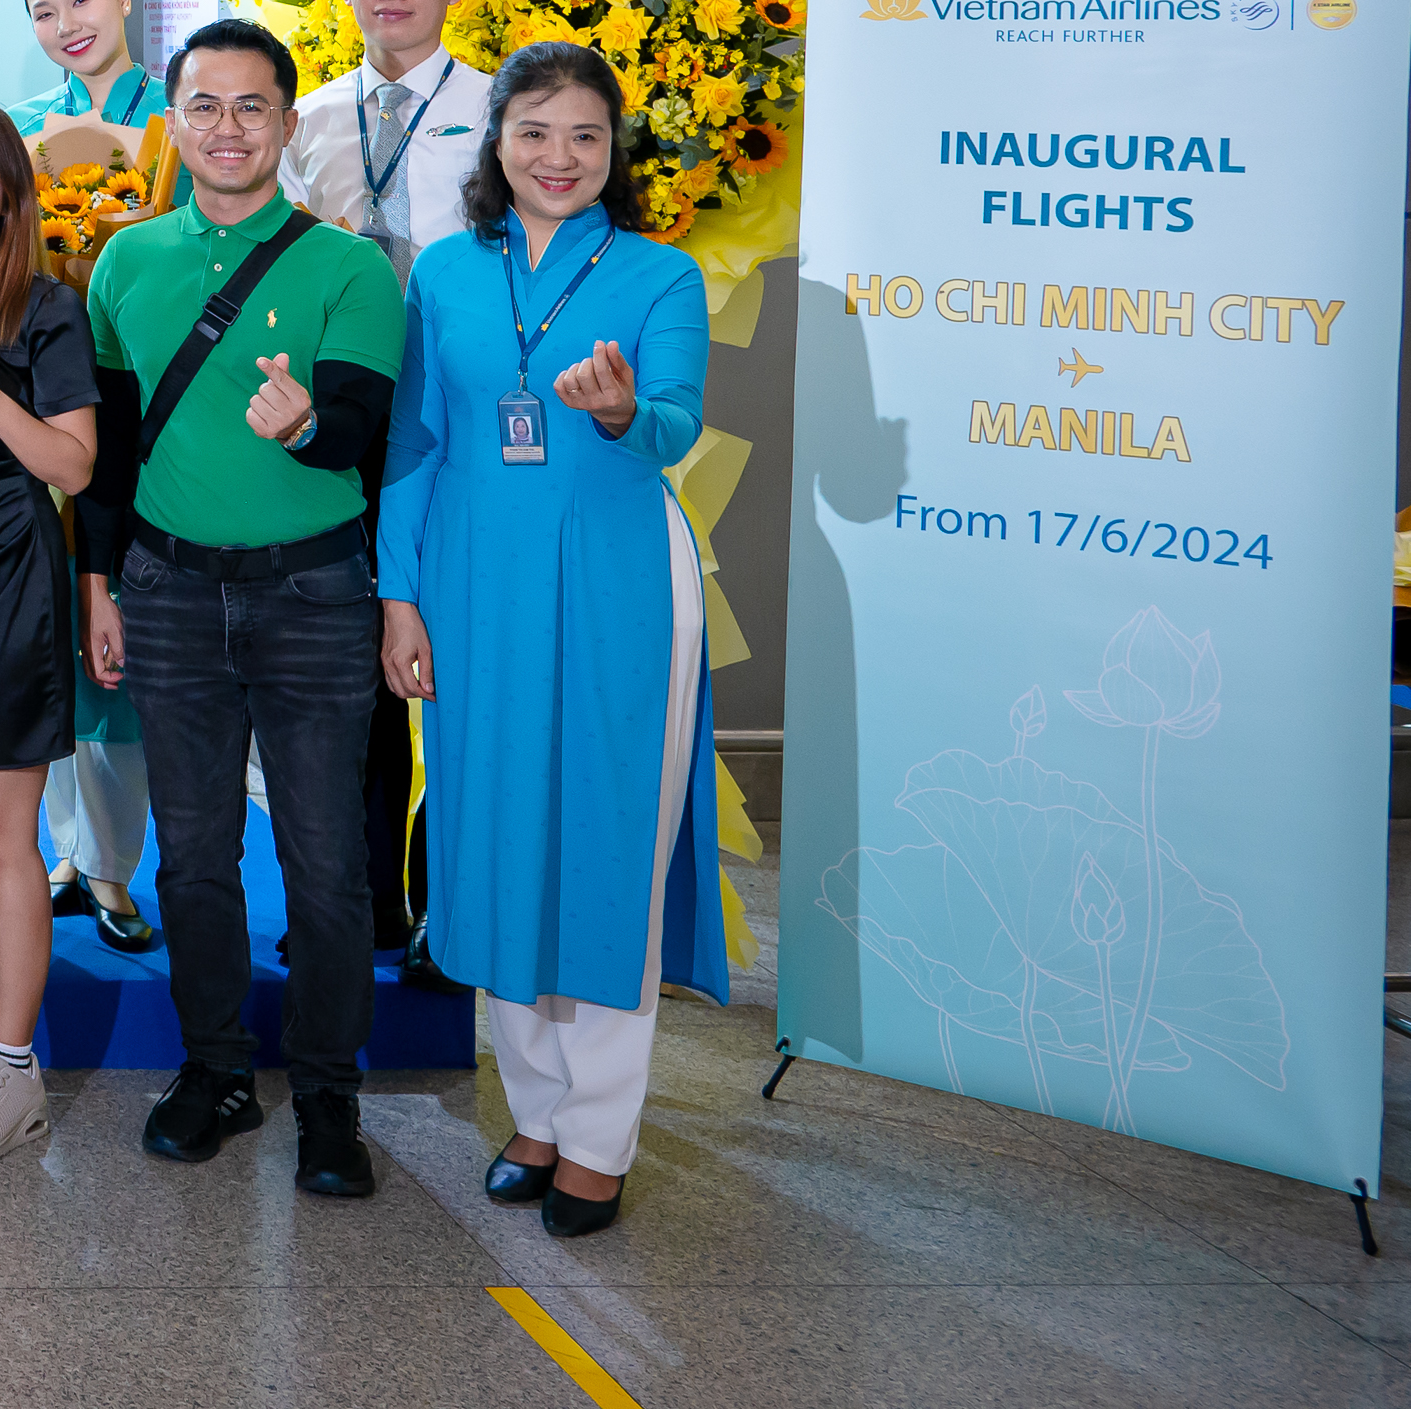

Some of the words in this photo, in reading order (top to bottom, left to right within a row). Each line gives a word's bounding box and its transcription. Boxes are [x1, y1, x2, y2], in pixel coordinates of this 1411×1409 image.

[995, 28, 1054, 43] REACH
[1062, 29, 1145, 43] FURTHER
[939, 130, 1247, 174] INAUGURAL
[981, 190, 1195, 234] FLIGHTS
[844, 272, 925, 320] HO
[934, 277, 1026, 326] CHI
[1038, 283, 1195, 338] MINH
[1208, 293, 1346, 347] CITY
[967, 399, 1193, 464] MANILA
[895, 494, 1008, 541] From
[1027, 508, 1274, 570] 17/6/2024
